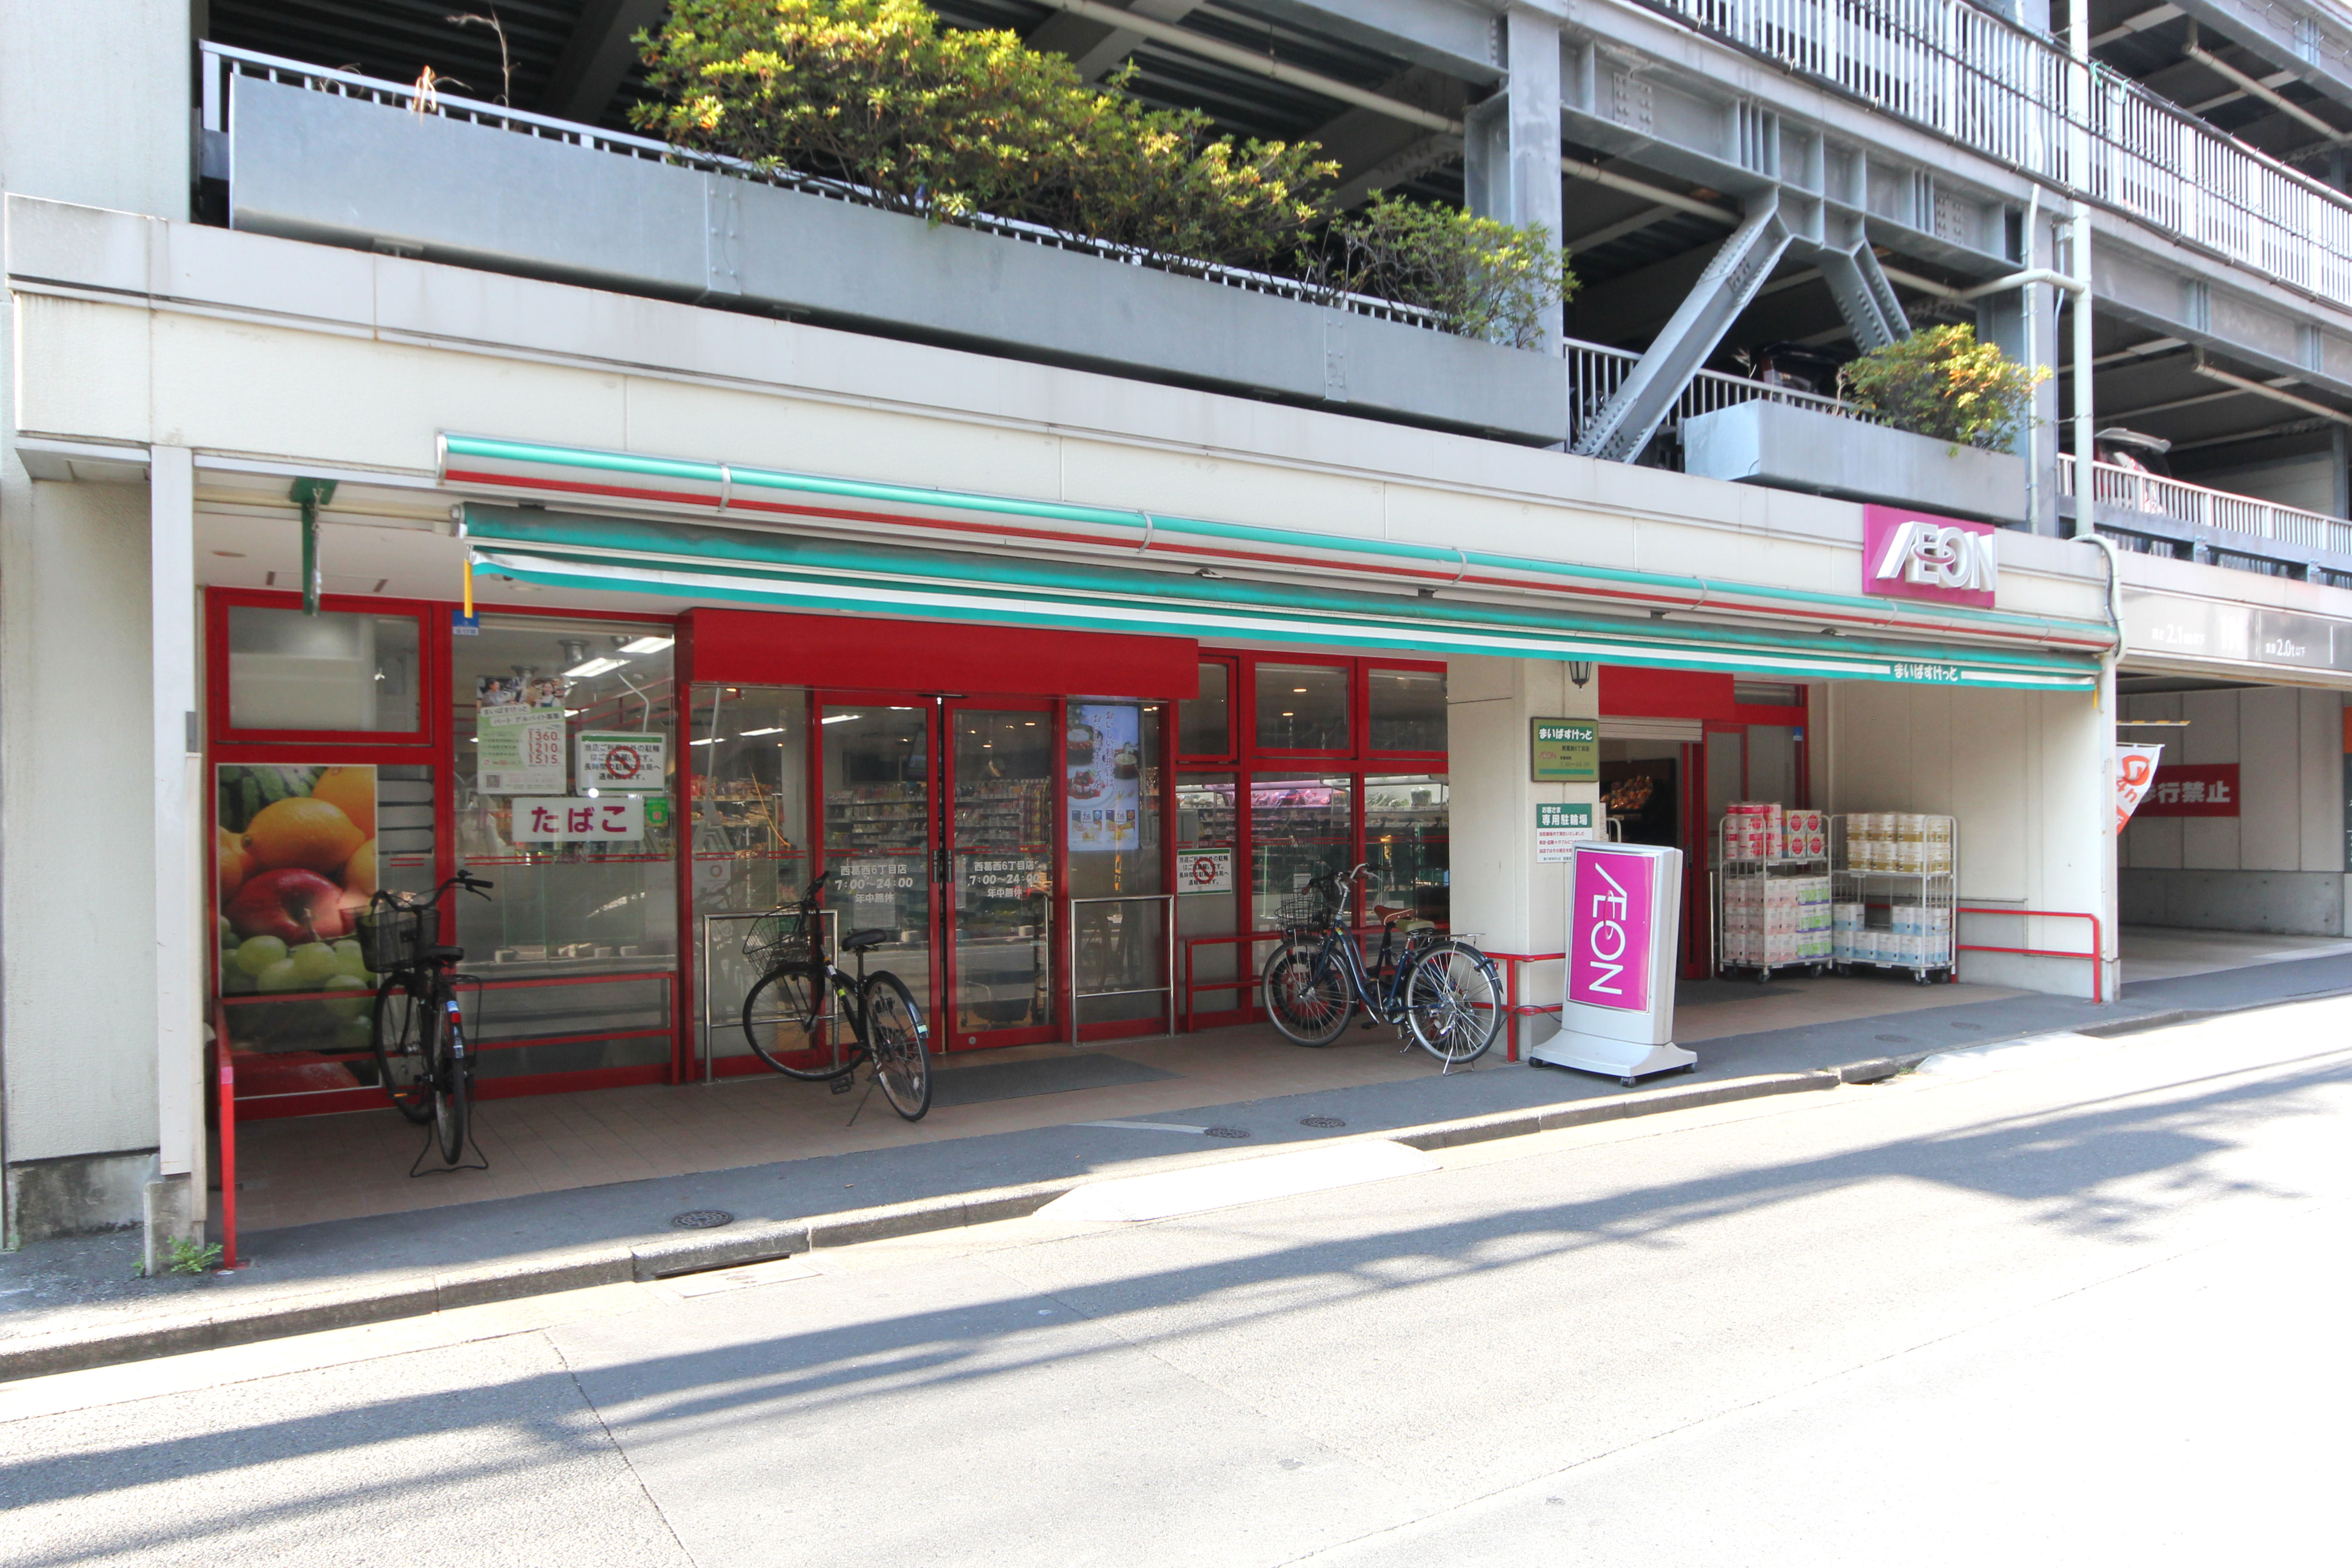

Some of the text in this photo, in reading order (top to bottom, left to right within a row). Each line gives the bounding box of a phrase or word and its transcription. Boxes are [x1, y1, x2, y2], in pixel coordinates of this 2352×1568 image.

[1894, 663, 1958, 682] まいばすけっと
[529, 731, 557, 740] 1360
[1539, 728, 1592, 740] まいばすけっと
[529, 743, 558, 753] 1210
[1093, 714, 1102, 789] おいしいチーズを
[1106, 711, 1115, 790] おいしい料理には、
[529, 755, 558, 764] 1515
[531, 806, 627, 833] たばこ
[1542, 814, 1588, 825] 専用駐輪場
[840, 864, 907, 876] 西葛西6丁目店
[974, 861, 1034, 872] 西葛西6丁目店
[855, 892, 894, 903] 年中無休
[987, 887, 1022, 898] 年中無休
[1589, 862, 1627, 995] AEON
